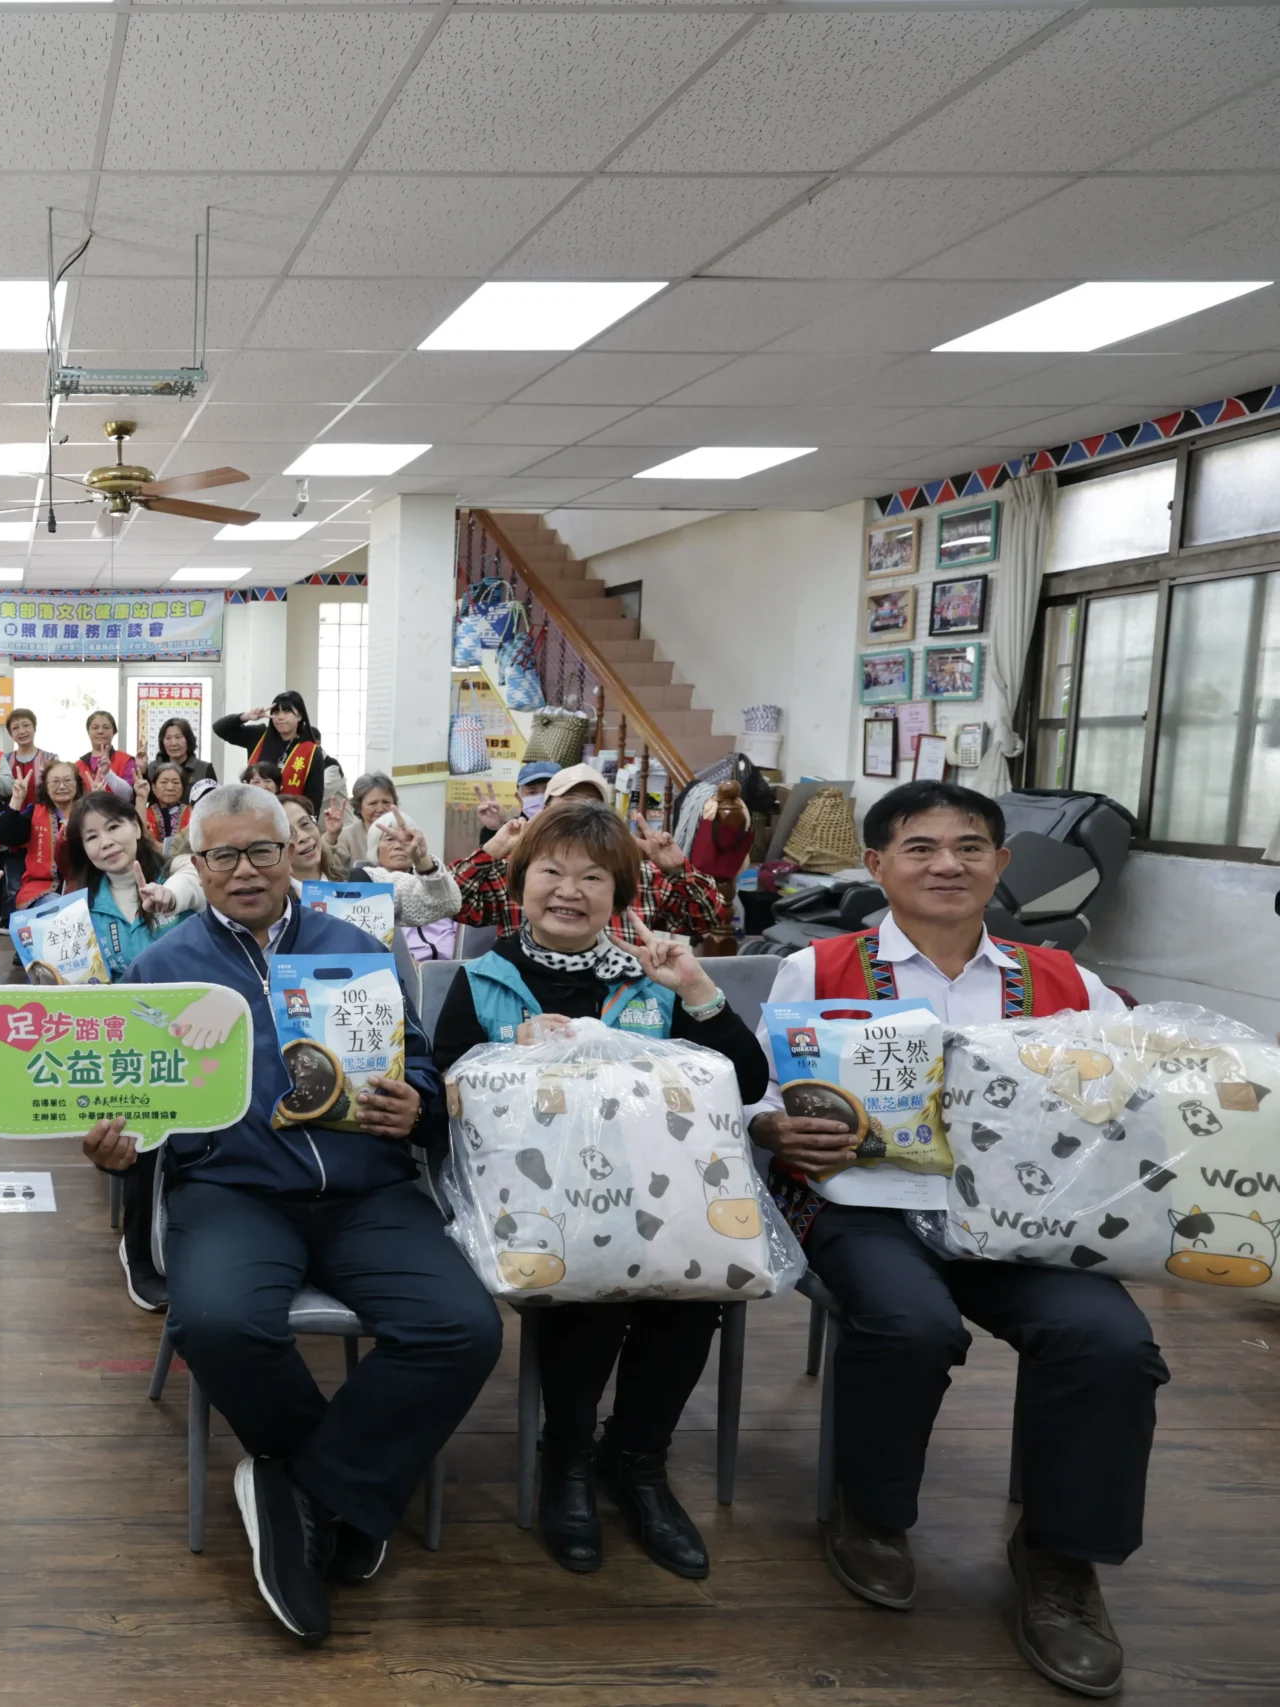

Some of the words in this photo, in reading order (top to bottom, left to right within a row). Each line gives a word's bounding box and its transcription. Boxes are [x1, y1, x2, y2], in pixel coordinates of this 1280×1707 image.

[352, 905, 370, 915] 100
[342, 989, 367, 1004] 100
[288, 1006, 310, 1014] QUAKER
[332, 1003, 393, 1027] 全天然
[7, 1011, 127, 1043] 足步踏實
[500, 1025, 514, 1040] 局
[864, 1026, 897, 1041] 100
[347, 1027, 384, 1054] 五麥
[791, 1045, 819, 1054] QUAKER
[853, 1040, 930, 1066] 全天然
[26, 1048, 187, 1086] 公益剪趾
[343, 1056, 388, 1071] 黑芝麻糊
[797, 1059, 818, 1068] 桂格
[1152, 1057, 1210, 1075] OW
[870, 1065, 918, 1093] 五麥
[32, 1098, 67, 1107] 指導單位
[866, 1095, 925, 1111] 黑芝麻糊
[941, 1087, 975, 1109] OW
[32, 1112, 67, 1121] 主辦單位
[708, 1112, 742, 1139] WO
[565, 1187, 634, 1214] WOW
[989, 1206, 1077, 1239] WOW
